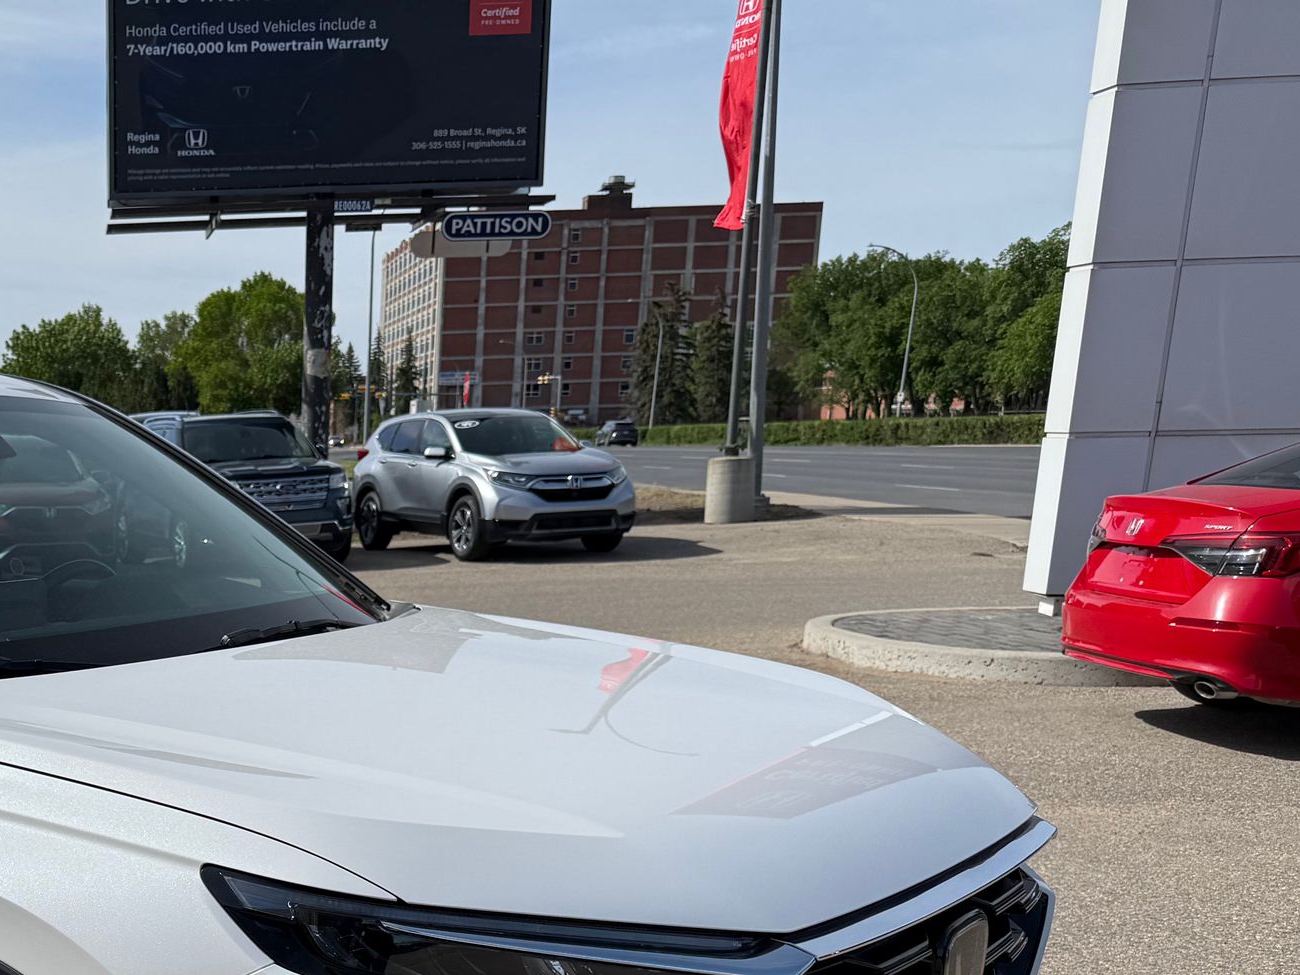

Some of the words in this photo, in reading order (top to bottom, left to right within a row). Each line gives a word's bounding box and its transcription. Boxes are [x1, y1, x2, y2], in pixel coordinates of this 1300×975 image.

[481, 7, 520, 17] Certified
[126, 24, 167, 37] Honda
[170, 22, 224, 36] Certified
[227, 21, 260, 35] Used
[263, 19, 316, 33] Vehicles
[319, 17, 366, 31] include
[369, 20, 377, 30] a
[126, 42, 224, 57] 7-Year/160,000
[227, 41, 248, 54] km
[251, 38, 324, 52] Powertrain
[326, 36, 389, 51] Warranty
[449, 128, 473, 136] Broad
[516, 126, 527, 135] SK
[126, 132, 160, 144] Regina
[127, 145, 159, 155] Honda
[466, 139, 527, 150] reginahonda.ca
[177, 149, 216, 157] HONDA
[450, 217, 544, 235] PATTISON
